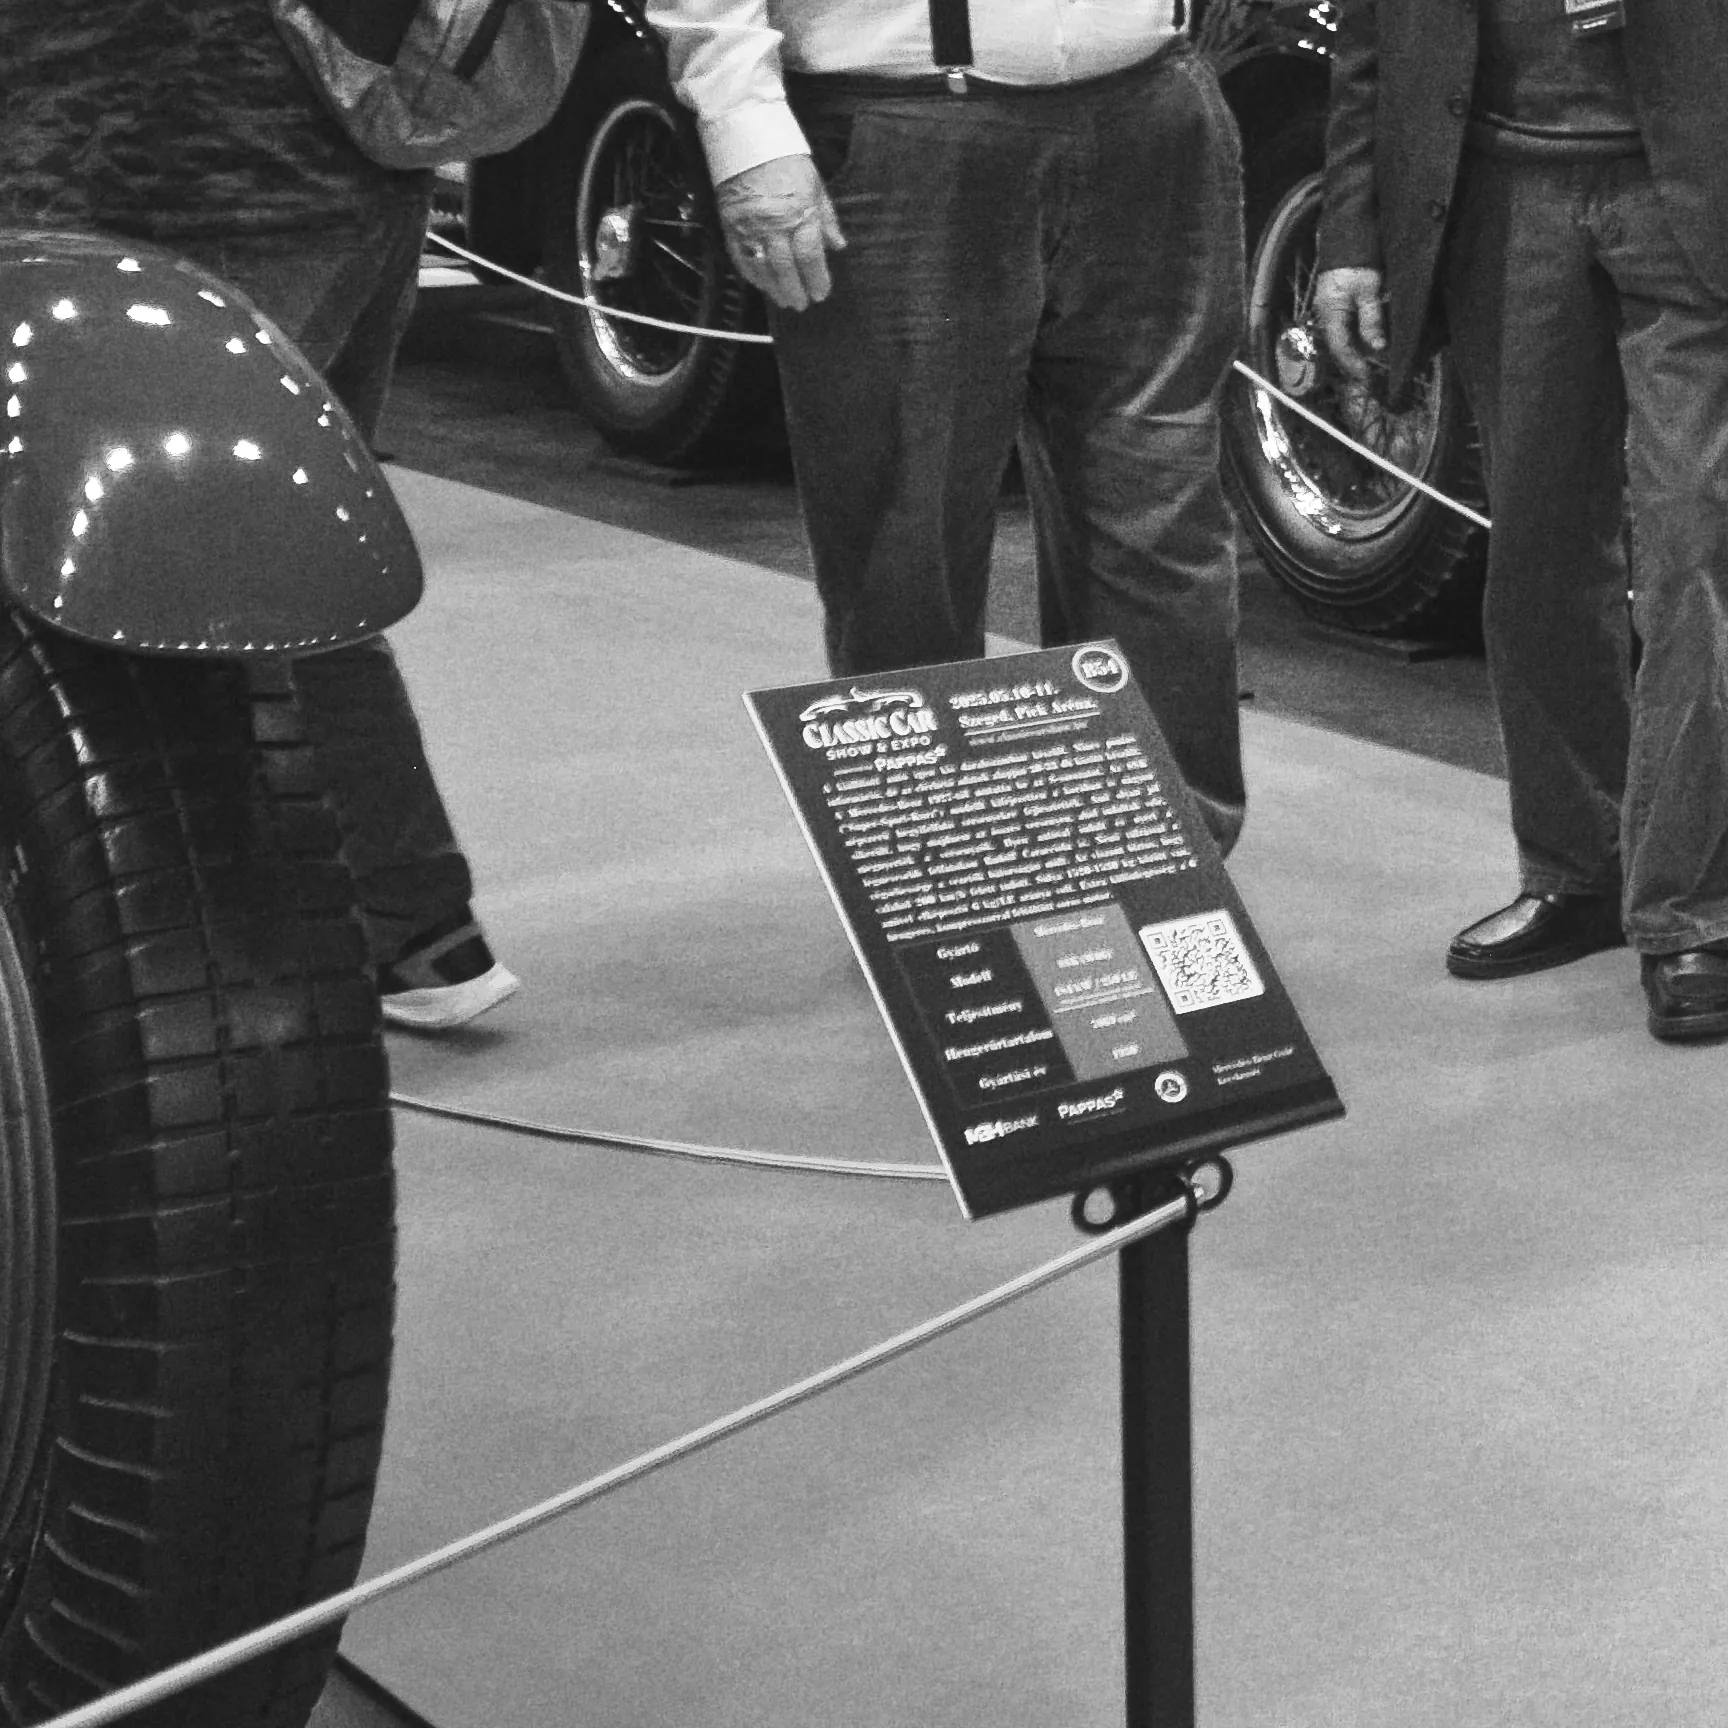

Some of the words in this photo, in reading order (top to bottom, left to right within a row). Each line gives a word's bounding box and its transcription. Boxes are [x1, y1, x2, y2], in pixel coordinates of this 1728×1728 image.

[803, 715, 892, 749] CLASSIC
[889, 708, 938, 736] CAR
[826, 744, 872, 761] SHOW
[891, 735, 931, 751] EXPO
[874, 752, 938, 772] PAPPAS
[1057, 1096, 1116, 1119] PAPPAS
